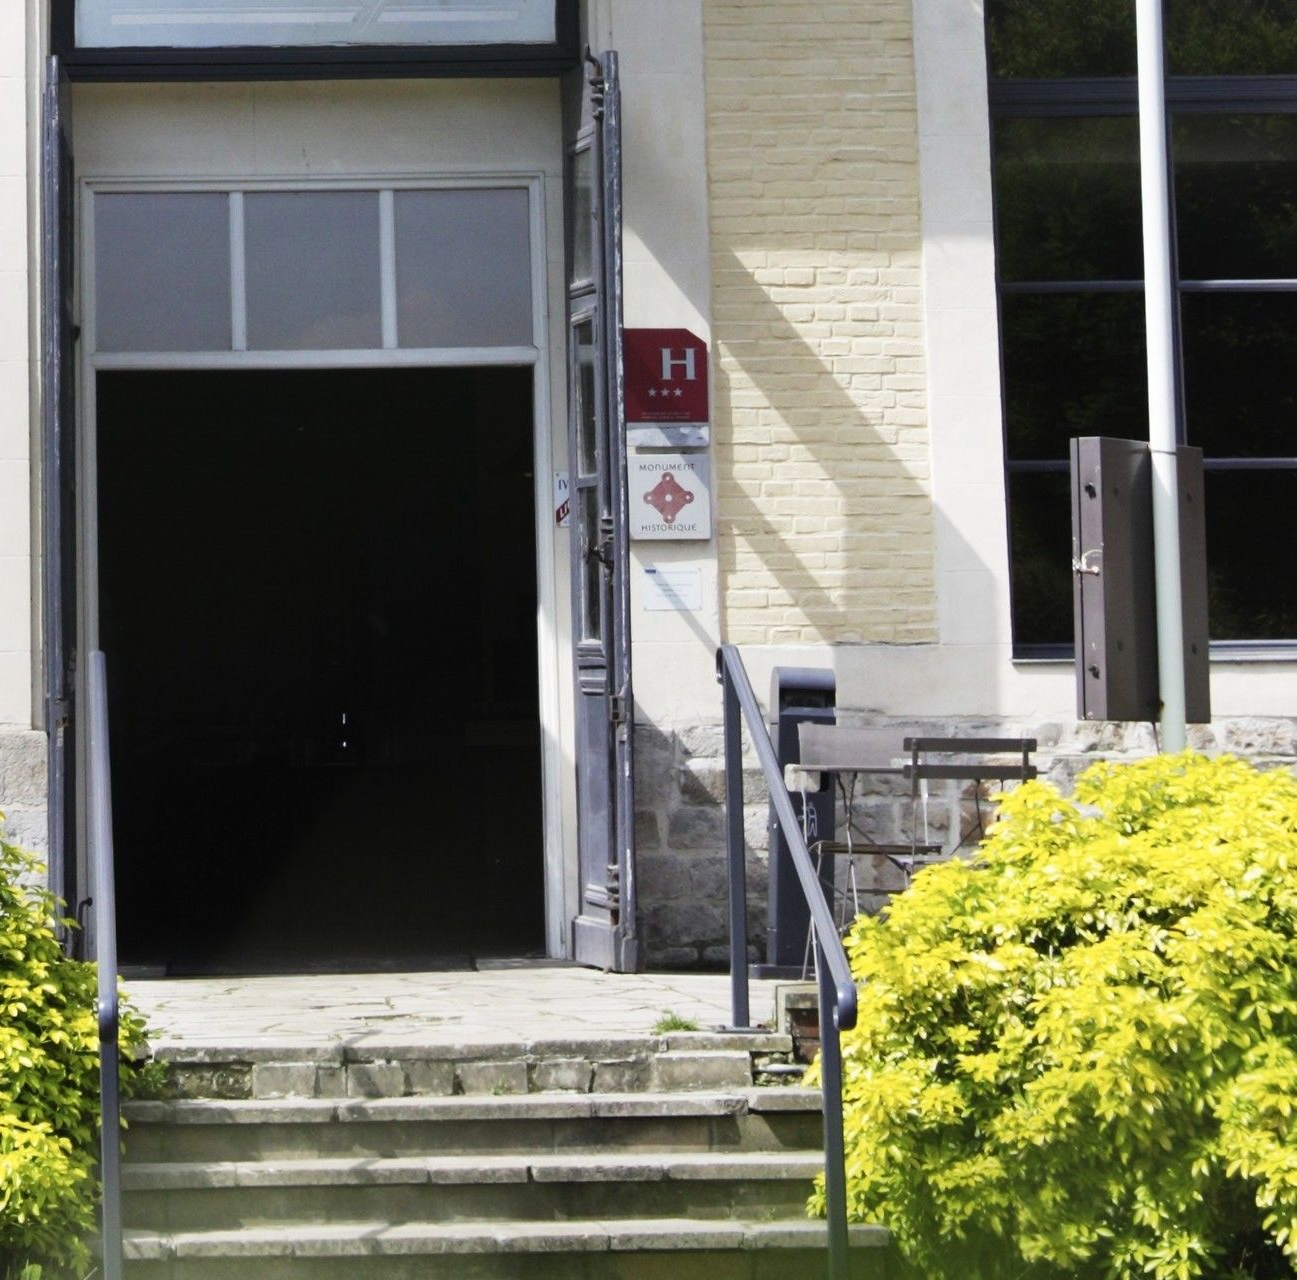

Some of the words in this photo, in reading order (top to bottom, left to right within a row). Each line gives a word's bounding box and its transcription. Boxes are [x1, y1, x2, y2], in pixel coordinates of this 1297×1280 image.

[660, 347, 697, 380] H
[639, 463, 694, 472] MONUMENT
[641, 523, 697, 532] HISTORIQUE
